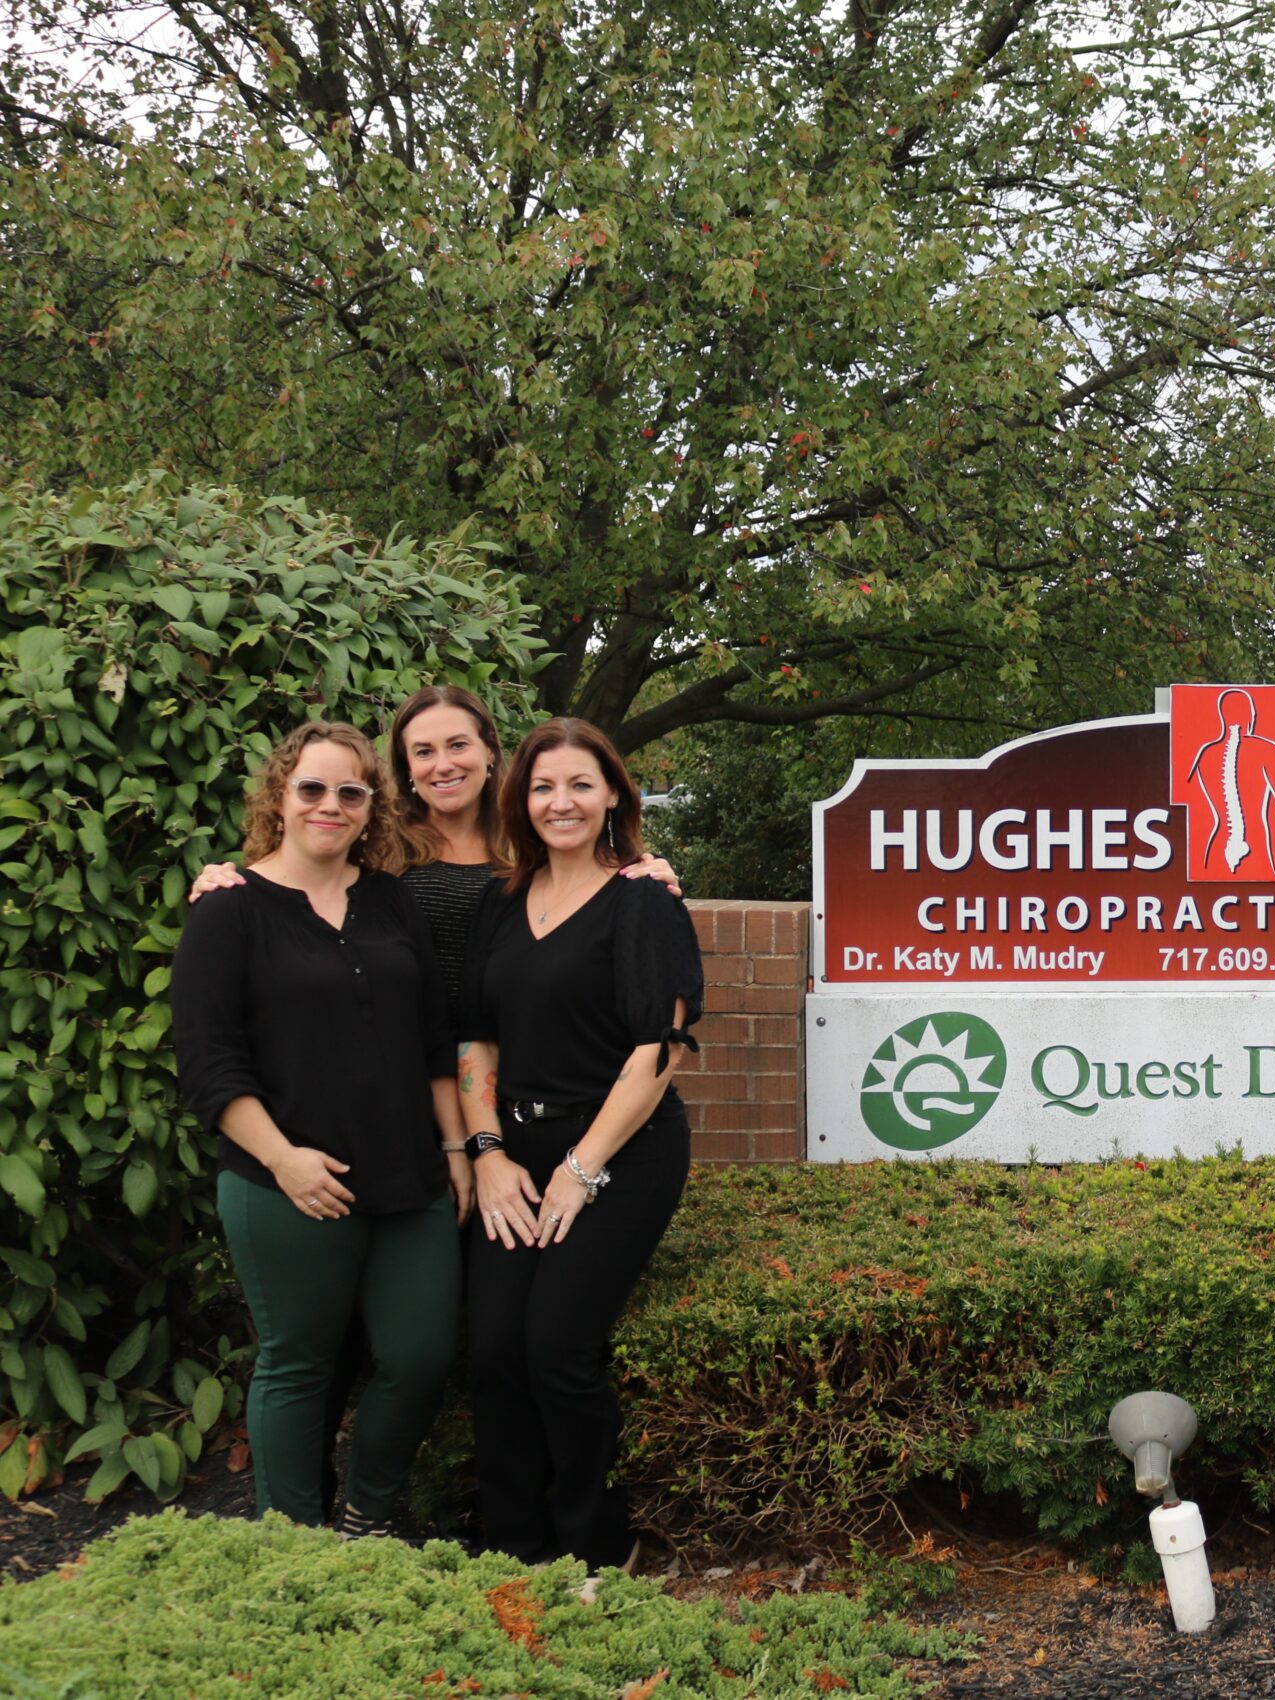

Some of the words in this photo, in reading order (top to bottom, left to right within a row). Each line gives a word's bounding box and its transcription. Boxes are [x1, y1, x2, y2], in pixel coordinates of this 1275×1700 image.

[870, 808, 1173, 871] HUGHES
[843, 946, 883, 971] Dr.
[894, 946, 960, 977] Katy
[970, 946, 1003, 970] M.
[1013, 945, 1105, 976] Mudry
[1031, 1045, 1222, 1116] Quest
